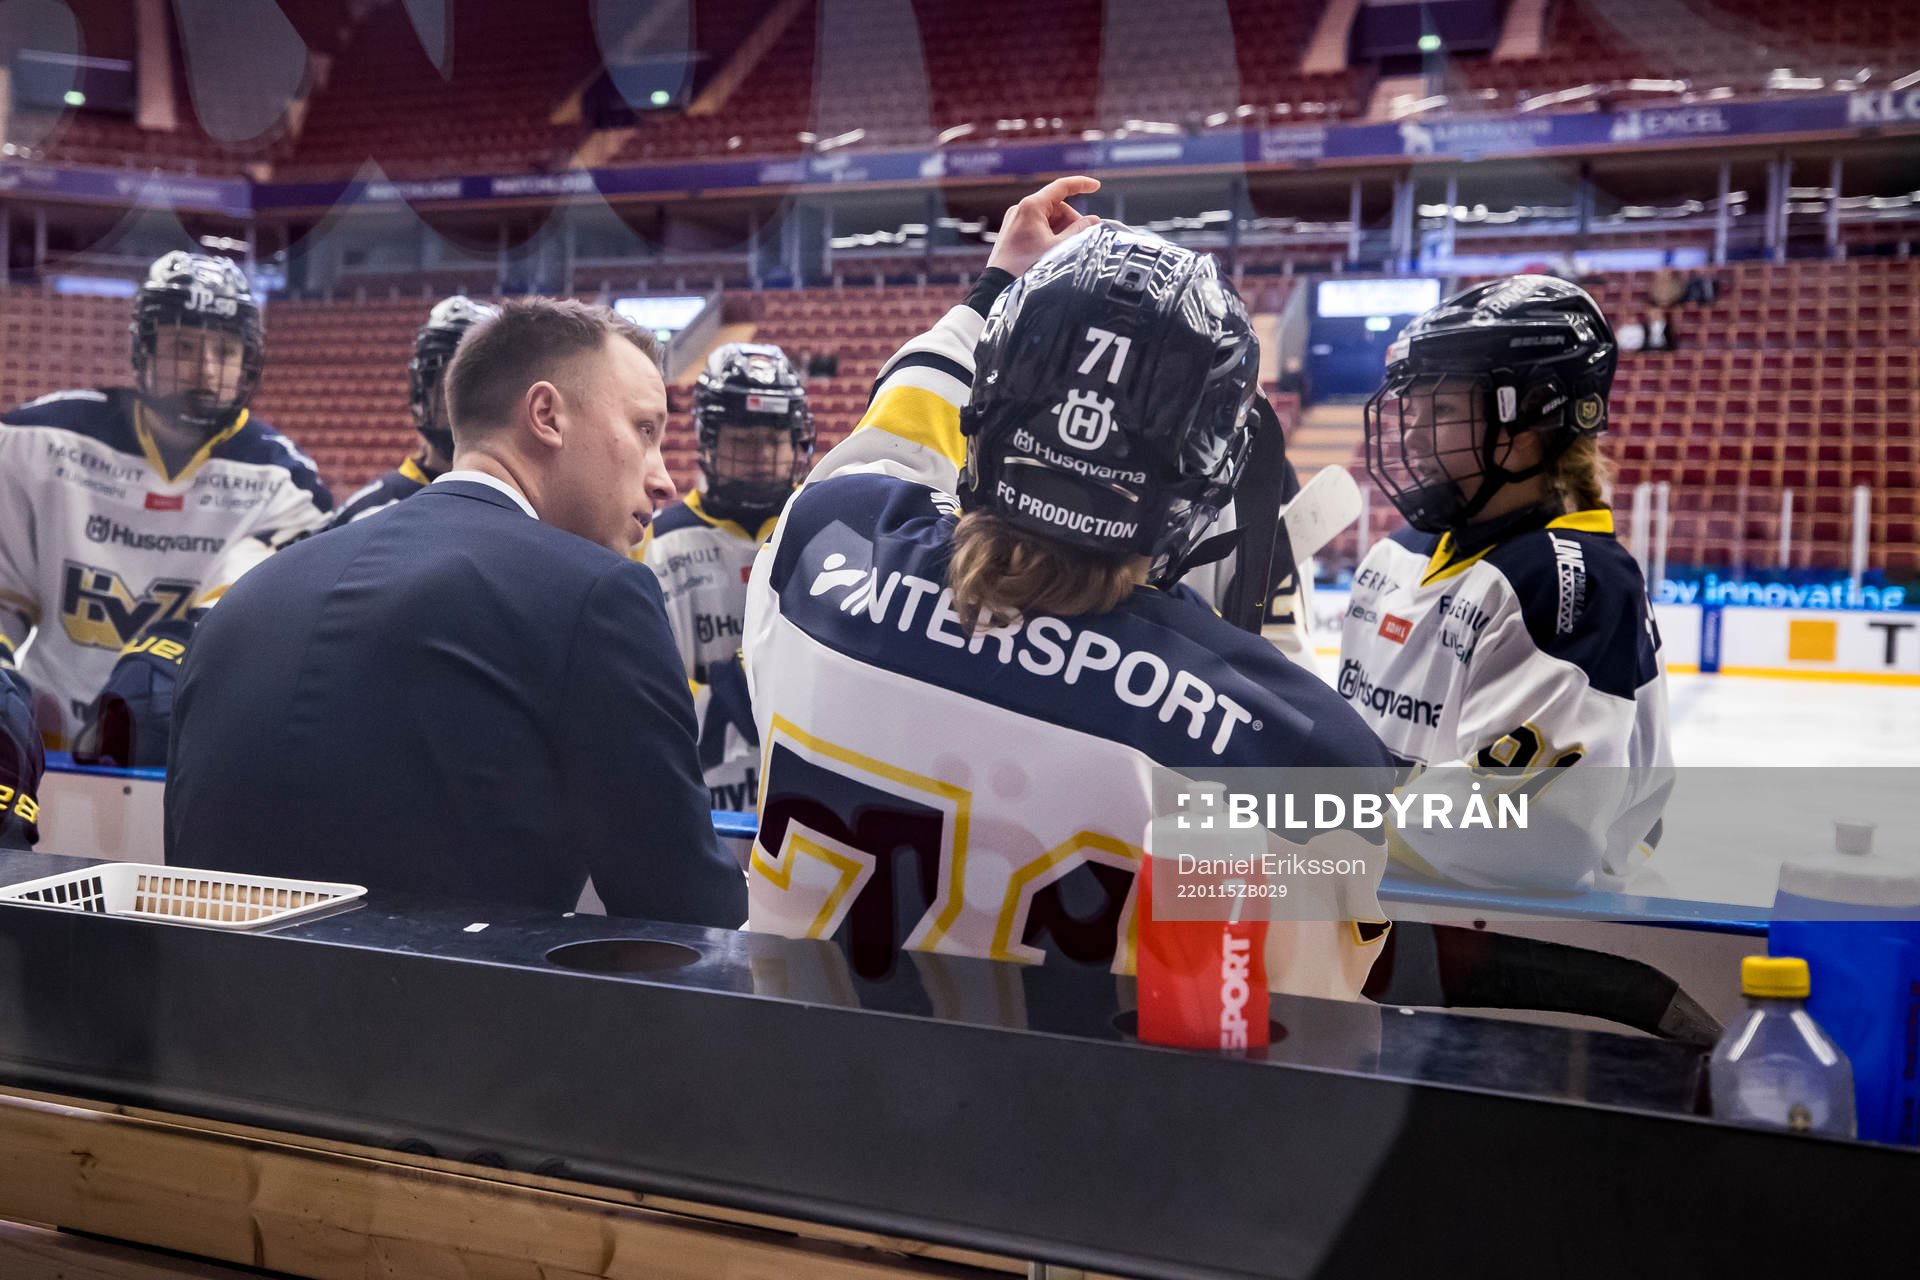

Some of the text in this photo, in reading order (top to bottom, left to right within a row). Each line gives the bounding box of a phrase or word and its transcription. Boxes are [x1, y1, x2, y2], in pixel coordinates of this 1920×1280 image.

[1077, 326, 1132, 384] 71
[1034, 441, 1147, 485] Husqvarna
[996, 480, 1139, 539] FC PRODUCTION
[1220, 932, 1250, 1048] SPORT
